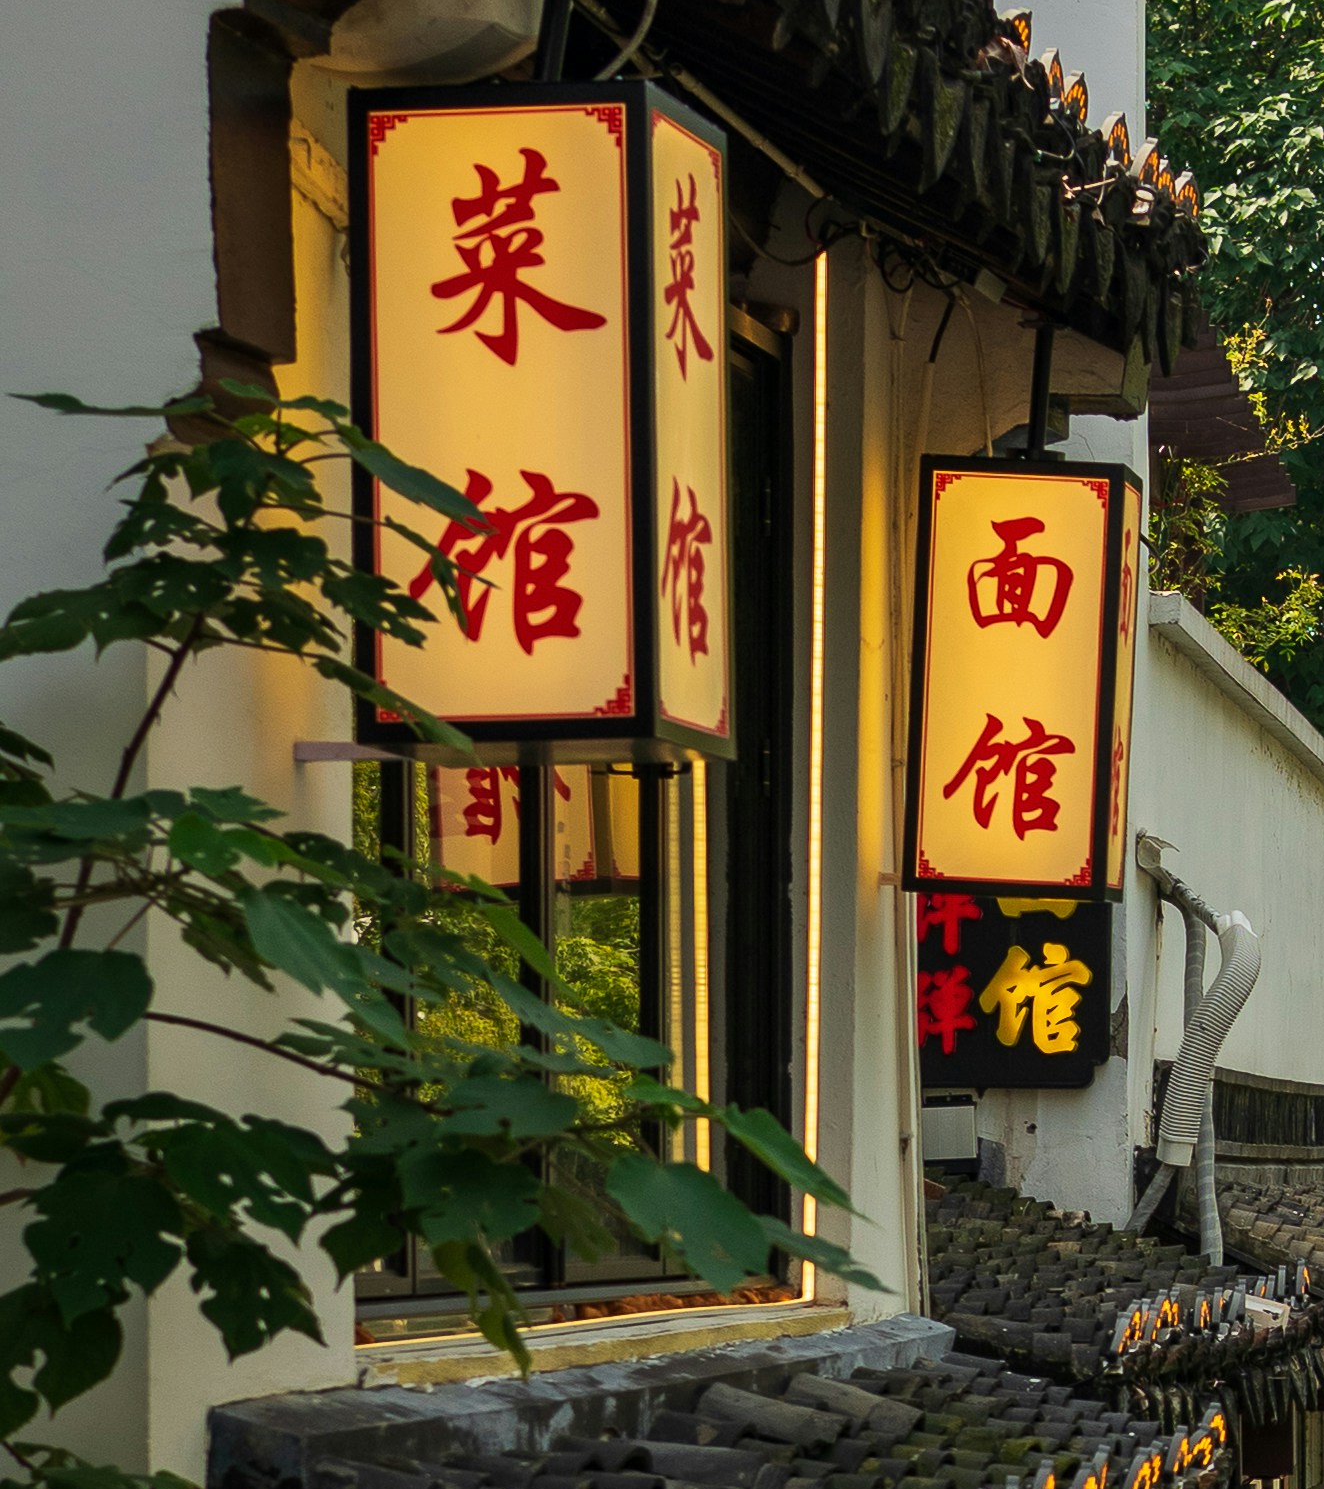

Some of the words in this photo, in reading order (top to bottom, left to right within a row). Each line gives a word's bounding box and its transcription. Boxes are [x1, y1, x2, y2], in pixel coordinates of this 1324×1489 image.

[409, 147, 608, 655] 菜馆
[660, 172, 714, 667] 菜馆
[942, 516, 1076, 842] 面馆
[979, 897, 1093, 1054] 馆
